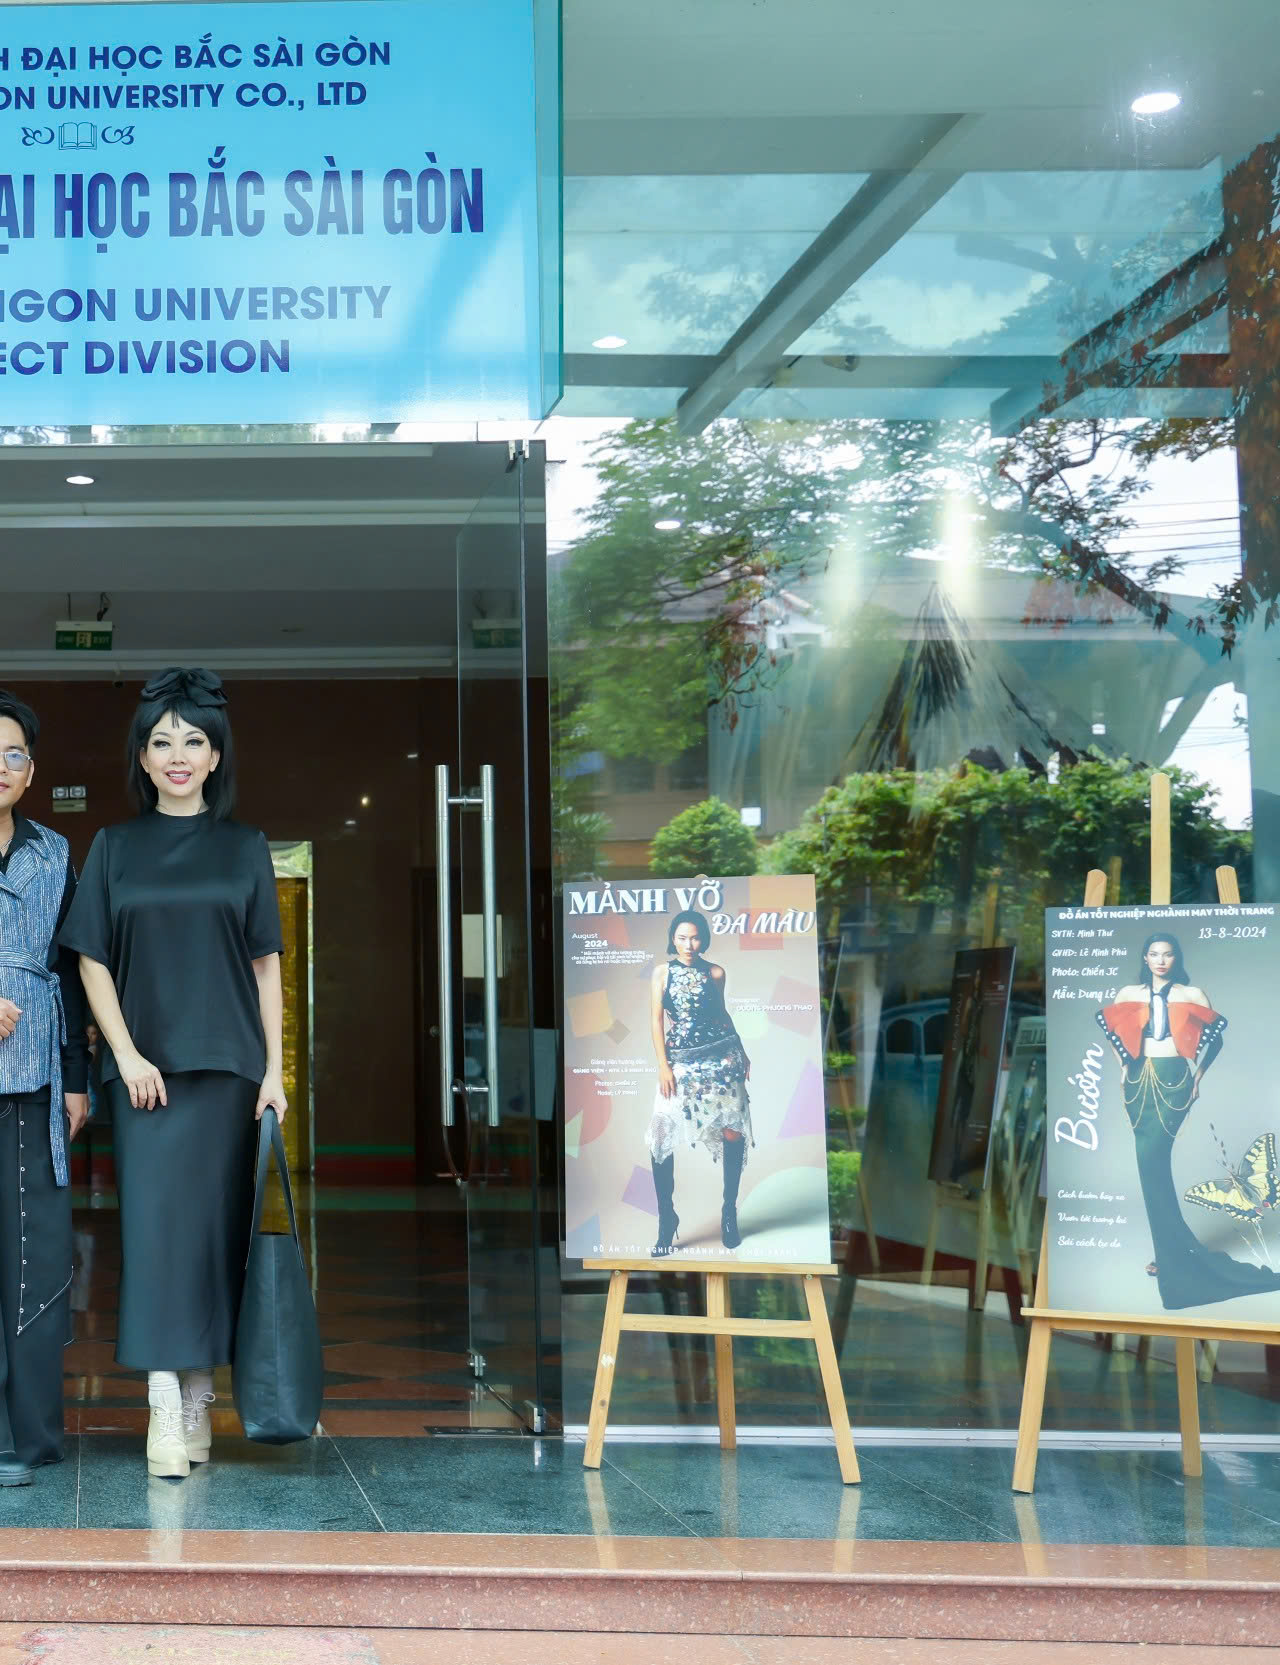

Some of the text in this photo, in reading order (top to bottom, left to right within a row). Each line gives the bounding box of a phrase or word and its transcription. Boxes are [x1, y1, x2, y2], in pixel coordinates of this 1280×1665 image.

[21, 46, 76, 77] ĐẠI
[89, 45, 163, 77] HỌC
[175, 32, 242, 69] BẮC
[253, 35, 303, 68] SÀI
[315, 34, 391, 67] GÒN
[47, 82, 225, 110] UNIVERSITY
[235, 82, 305, 111] CO.,
[317, 81, 367, 106] LTD
[54, 171, 150, 253] HỌC
[168, 145, 266, 238] BẮC
[283, 155, 364, 237] SÀI
[382, 151, 484, 235] GÒN
[135, 285, 391, 322] UNIVERSITY
[84, 339, 290, 375] DIVISION
[569, 879, 721, 915] MẢNH VỠ
[711, 908, 815, 935] ĐA MÀU
[1059, 907, 1275, 920] ĐỒ ÁN TỐT NGHIỆP NGHÀNH MAY THỜI TRANG
[572, 932, 599, 940] August
[1051, 929, 1075, 938] SVTH:
[1077, 929, 1095, 938] Minh
[1198, 926, 1267, 939] 13-8-2024
[584, 940, 609, 948] 2024
[1051, 948, 1078, 957] GVHD:
[1079, 948, 1089, 957] Lê
[1091, 948, 1109, 957] Minh
[1051, 964, 1119, 977] Photo: Chiến JC
[1052, 985, 1117, 1003] Mẫu: Dung Lê
[1054, 1042, 1104, 1151] Bướm
